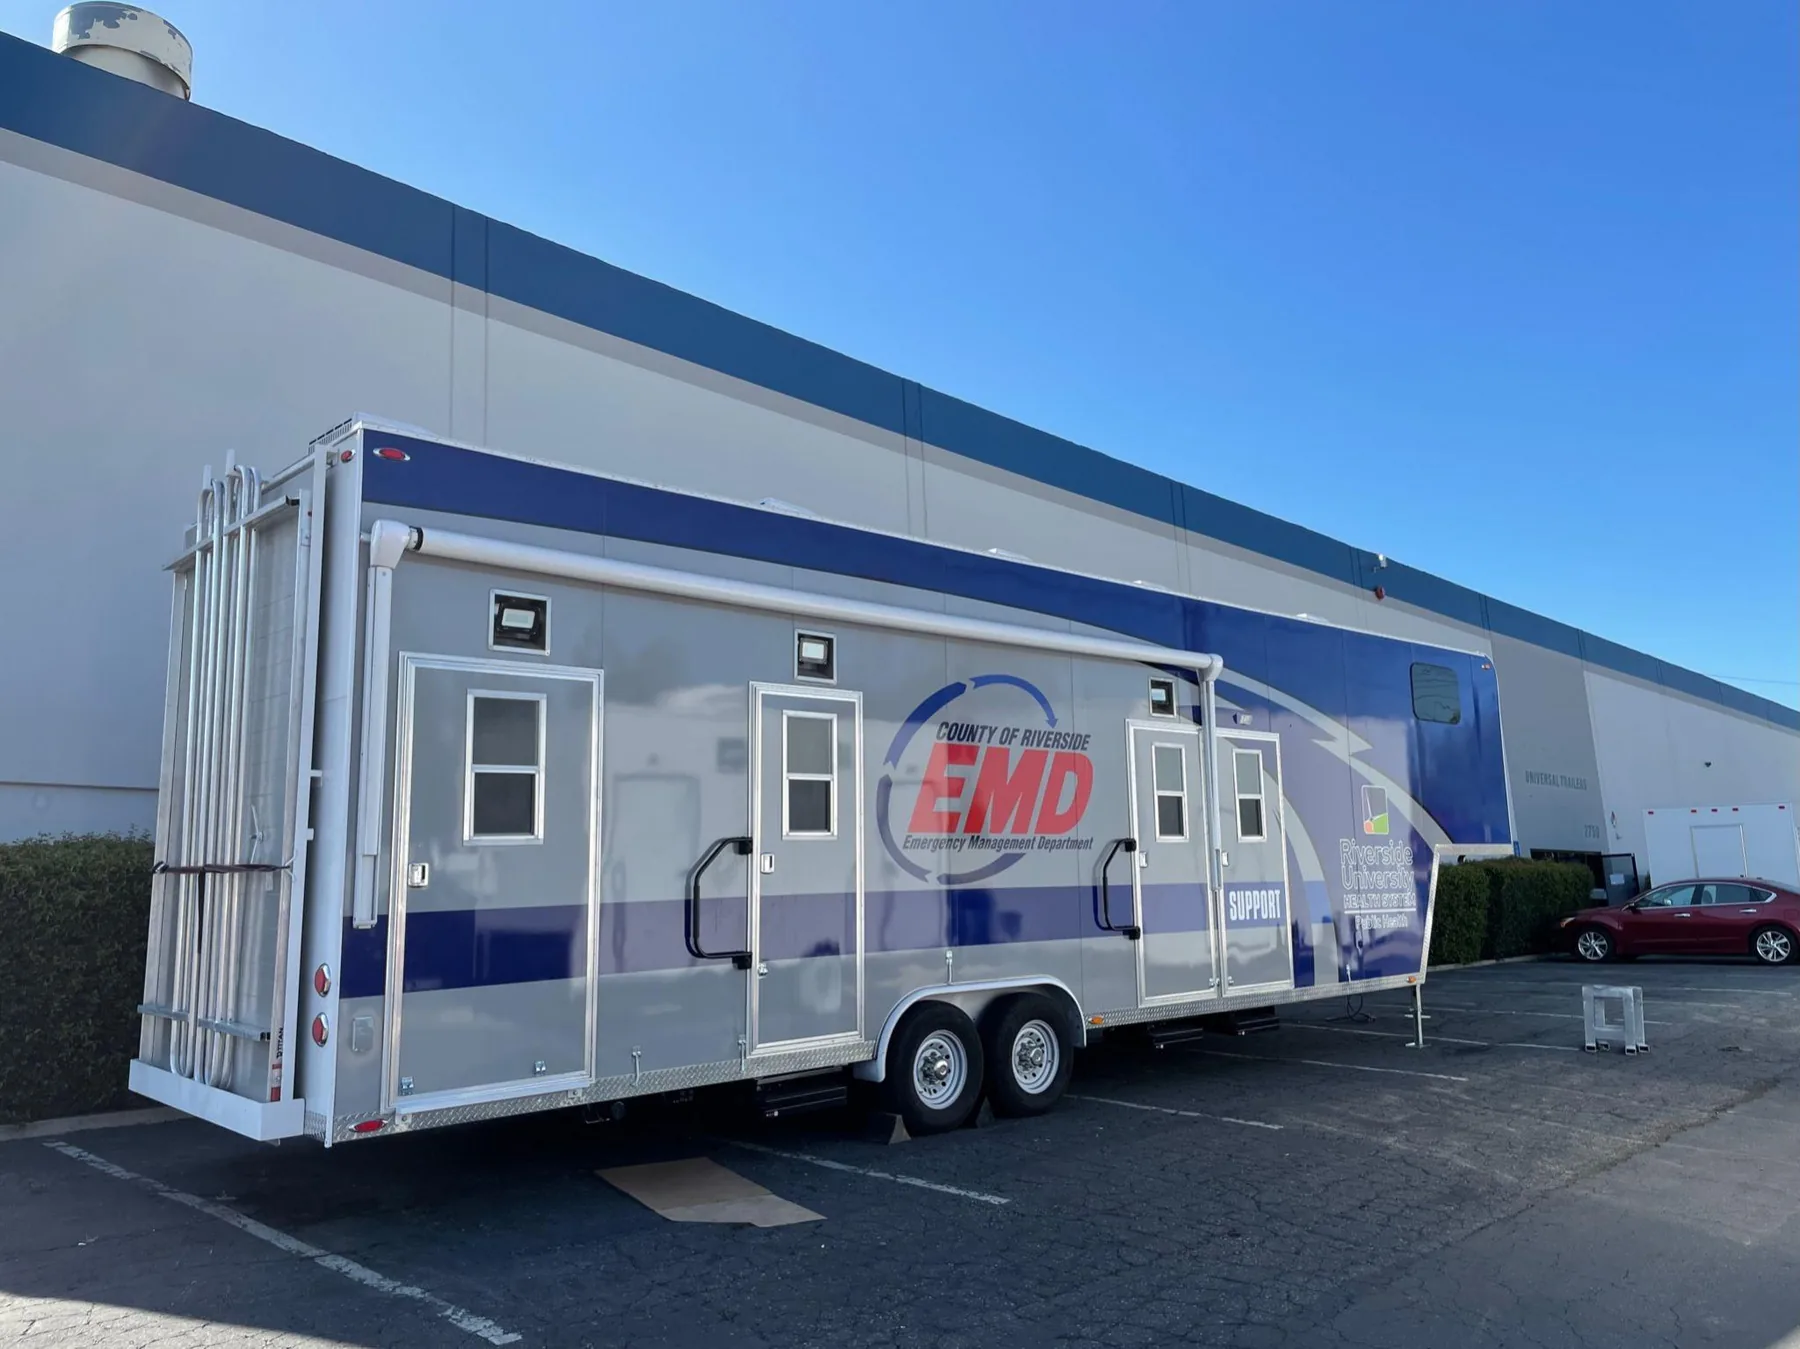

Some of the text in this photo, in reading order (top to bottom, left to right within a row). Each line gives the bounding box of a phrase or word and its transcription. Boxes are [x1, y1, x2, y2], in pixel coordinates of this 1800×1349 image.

[937, 722, 1091, 750] COUNTY OF RIVERSIDE
[908, 743, 1093, 834] EMD
[1526, 771, 1560, 787] UNIVERSAL
[903, 835, 1093, 852] Emergency Management Department
[1340, 838, 1414, 865] Riverside
[1341, 864, 1415, 893] University
[1229, 890, 1280, 920] SUPPORT
[1344, 893, 1416, 909] HEALTH SYSTEM
[1355, 913, 1408, 930] Public Health
